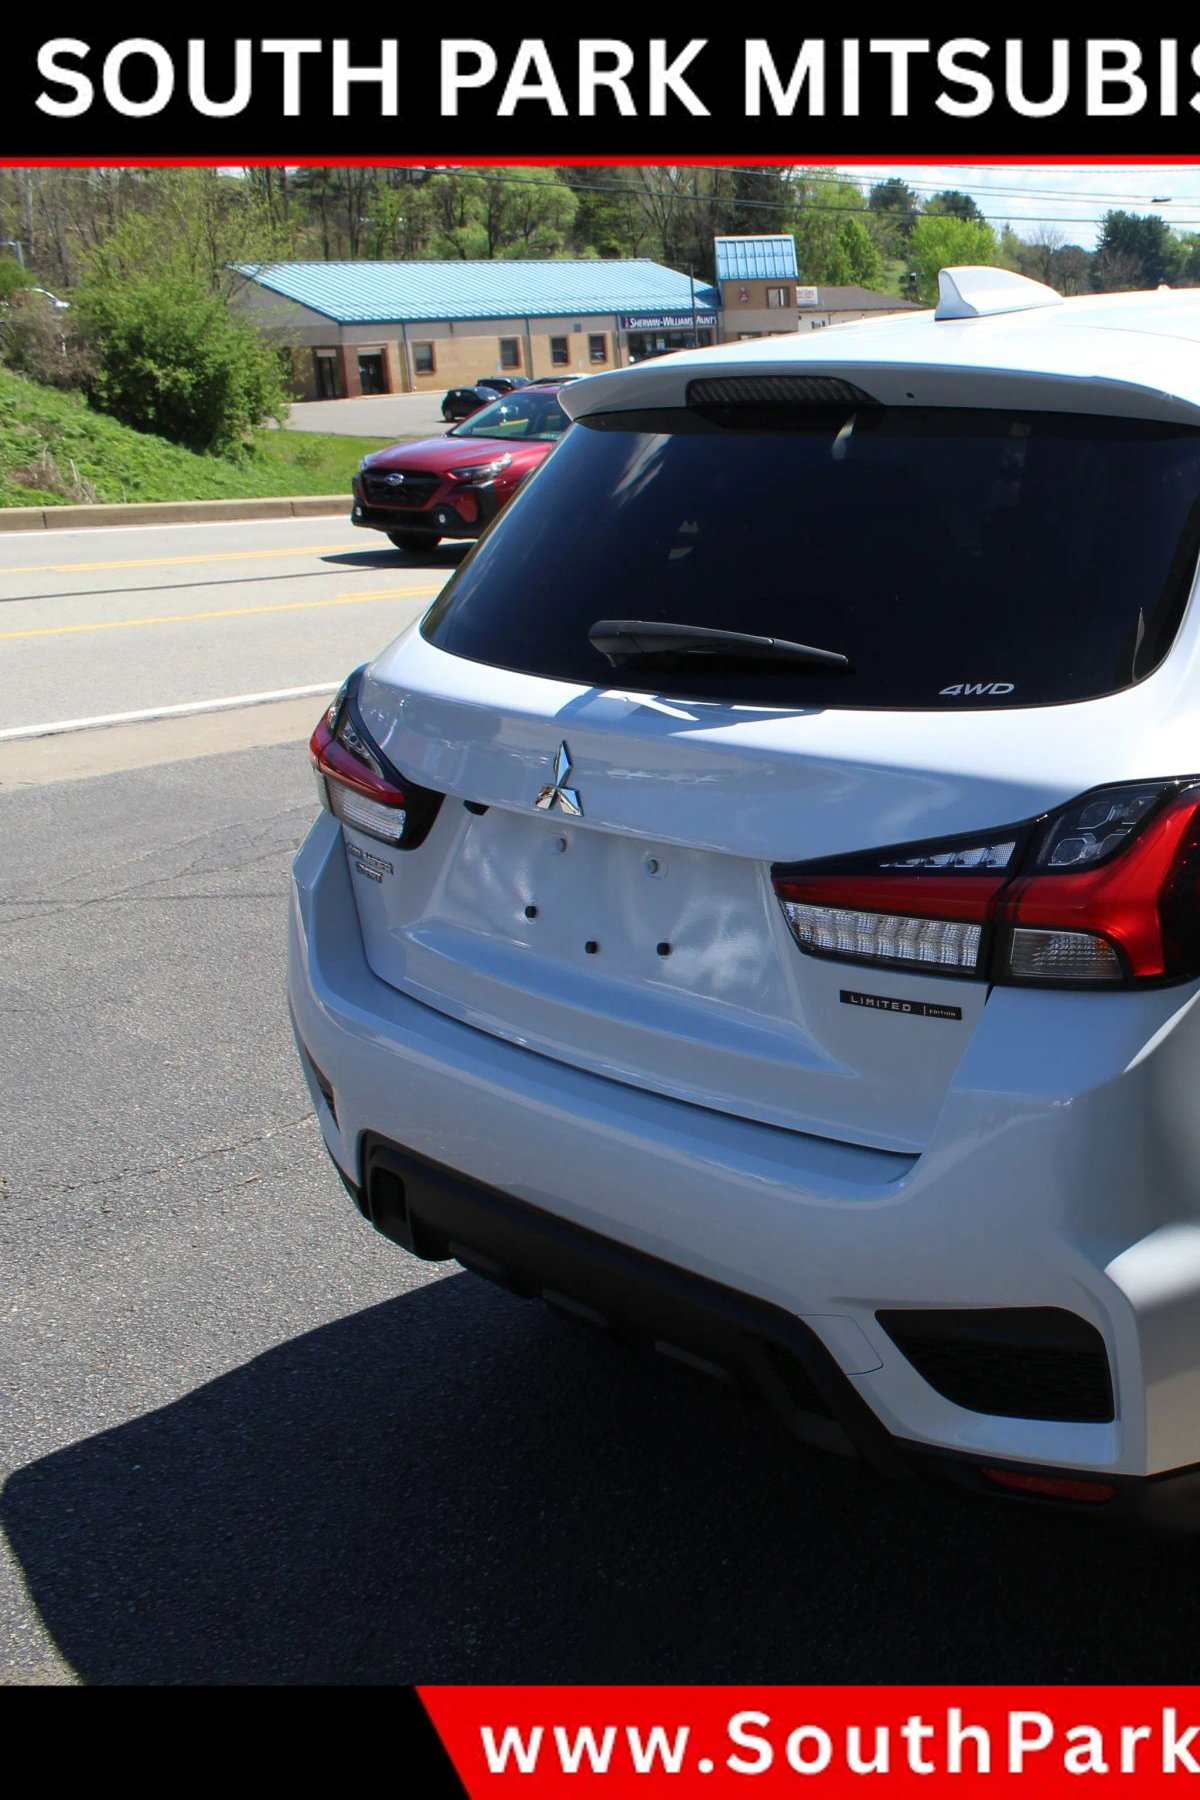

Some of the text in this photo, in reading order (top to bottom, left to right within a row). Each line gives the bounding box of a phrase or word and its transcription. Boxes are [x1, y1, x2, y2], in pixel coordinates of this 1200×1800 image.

[696, 315, 717, 325] PAINTS
[939, 683, 1015, 695] 4WD
[851, 995, 956, 1017] LIMITED EDITION
